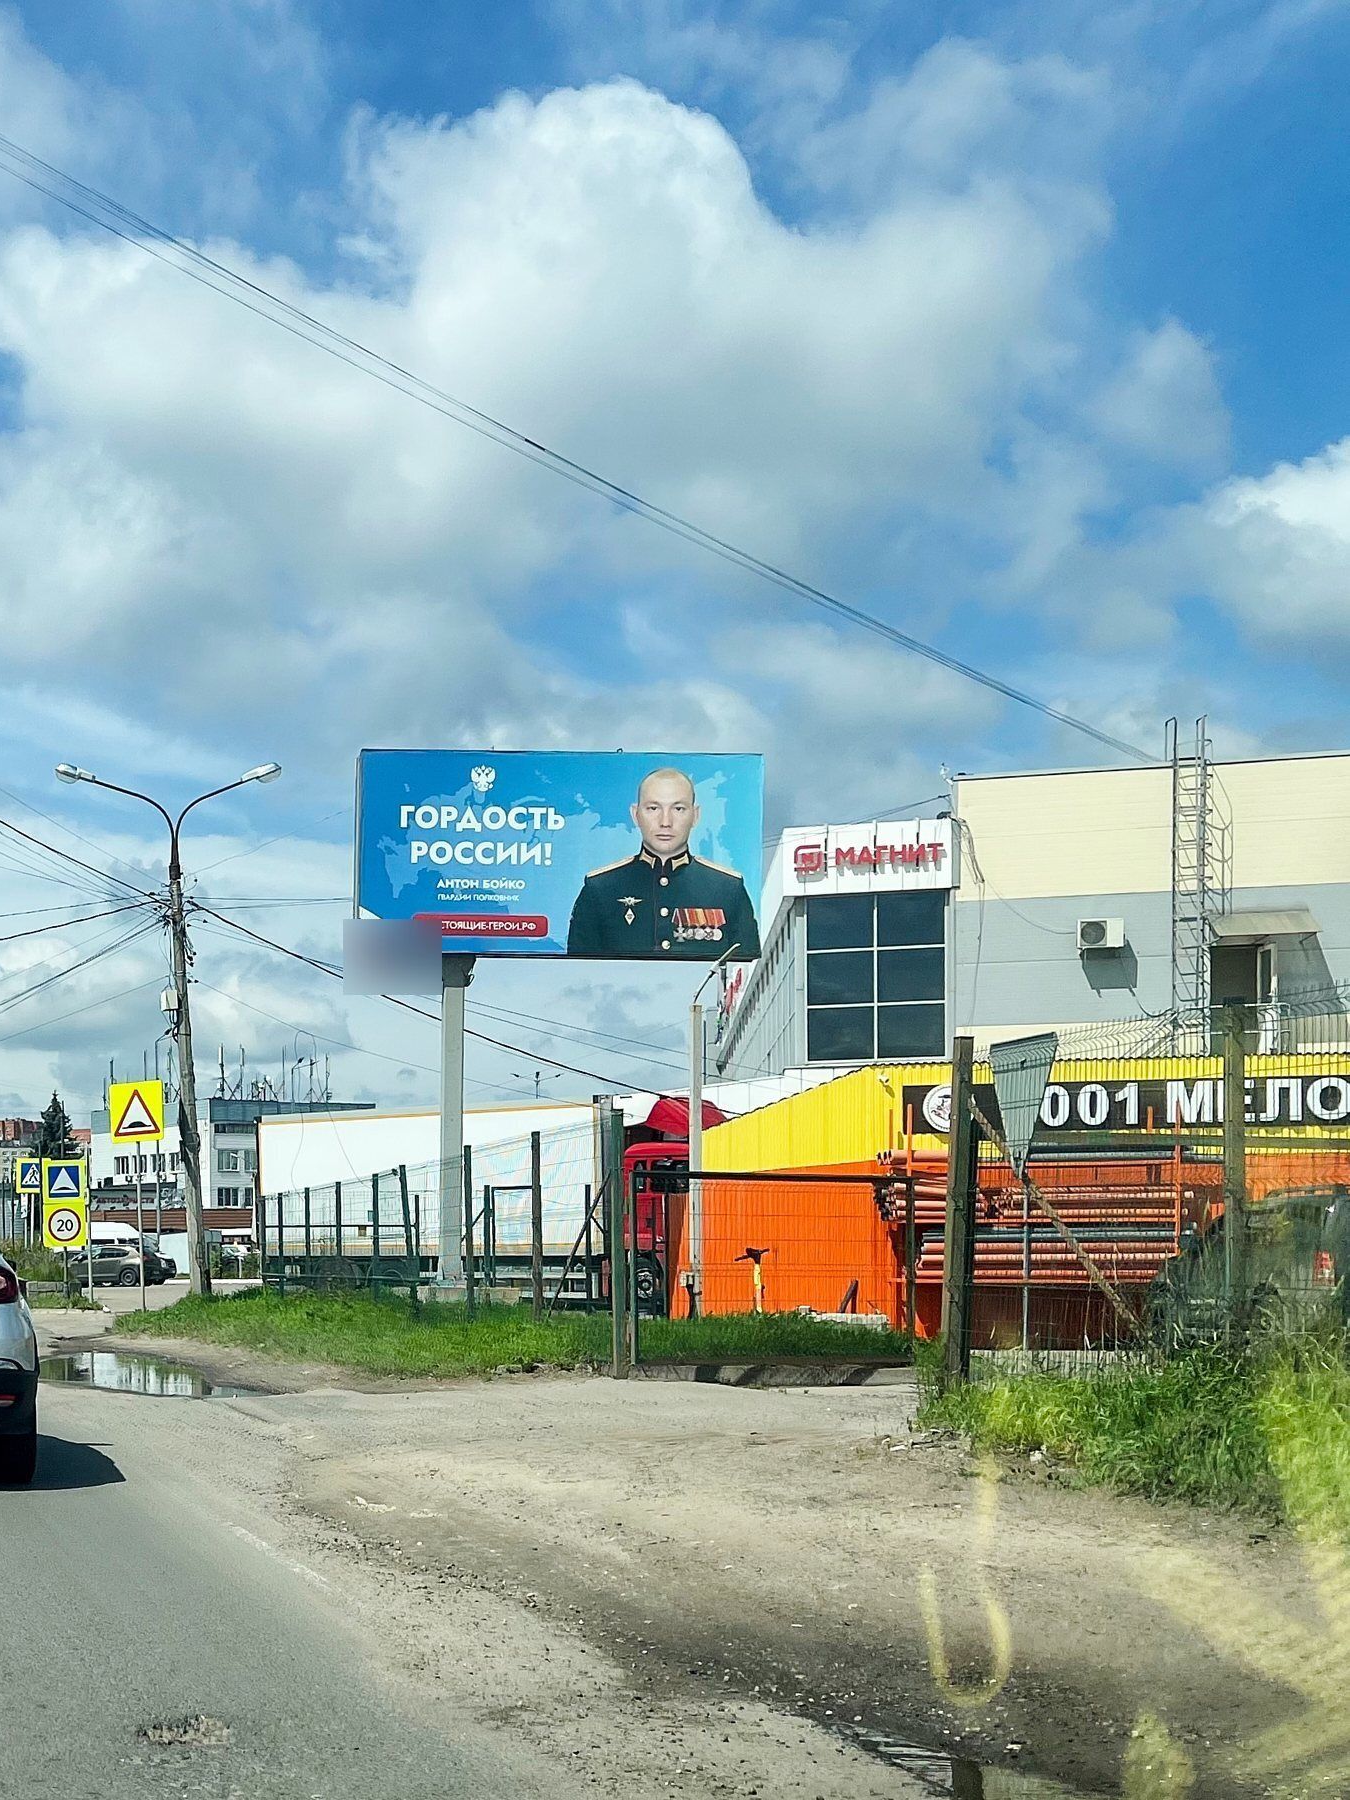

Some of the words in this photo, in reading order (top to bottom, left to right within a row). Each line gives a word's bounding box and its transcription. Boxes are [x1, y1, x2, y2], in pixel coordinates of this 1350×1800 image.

[400, 805, 566, 832] ГОРДОСТЬ
[410, 841, 553, 866] РОССИИ!
[835, 843, 944, 866] МАГНИТ
[437, 879, 479, 889] АНТОН
[483, 877, 526, 890] БОЙКО
[437, 894, 471, 902] ГВАРДИИ
[473, 894, 520, 902] ПОЛКОВНИК
[56, 1219, 73, 1232] 20
